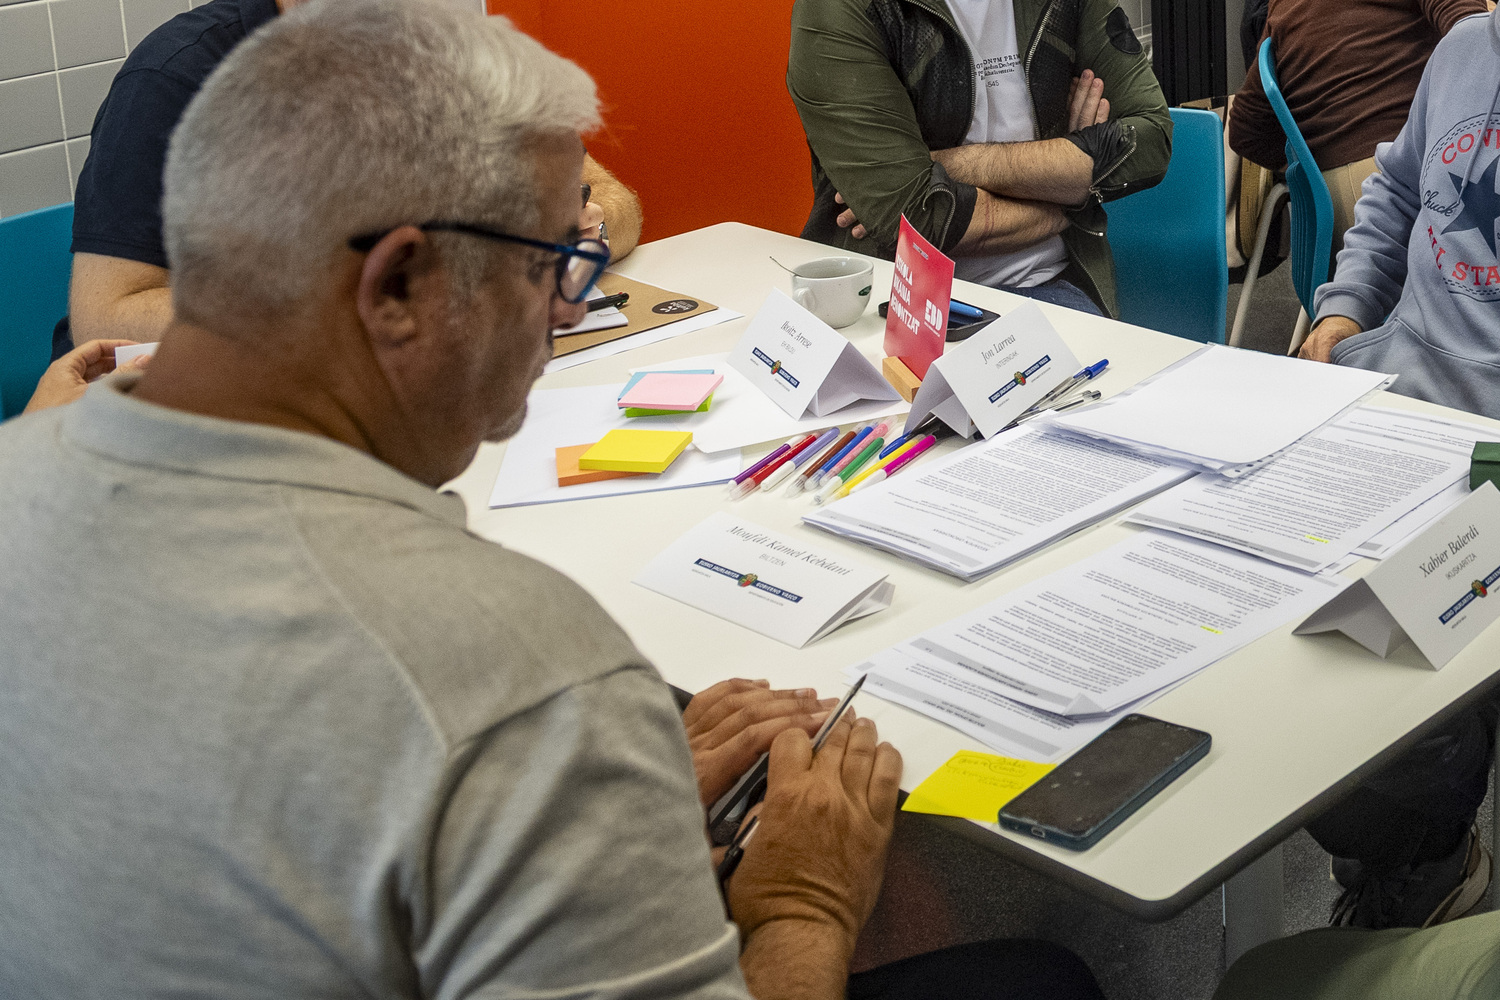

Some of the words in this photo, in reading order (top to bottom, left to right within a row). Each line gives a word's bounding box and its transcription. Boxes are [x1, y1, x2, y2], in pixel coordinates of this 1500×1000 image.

[1423, 189, 1460, 217] Chuck
[924, 298, 943, 332] EBD
[981, 350, 995, 365] Jon
[993, 334, 1016, 354] Larrea
[727, 525, 767, 546] Moufdi
[766, 540, 802, 559] Kamel
[1419, 549, 1449, 578] Xabier
[1448, 524, 1479, 555] Balerdi
[759, 553, 787, 567] BILTZEN
[1445, 553, 1477, 580] IKUSKARITZA
[755, 581, 781, 595] GOBIERNO
[781, 591, 798, 601] VASCO
